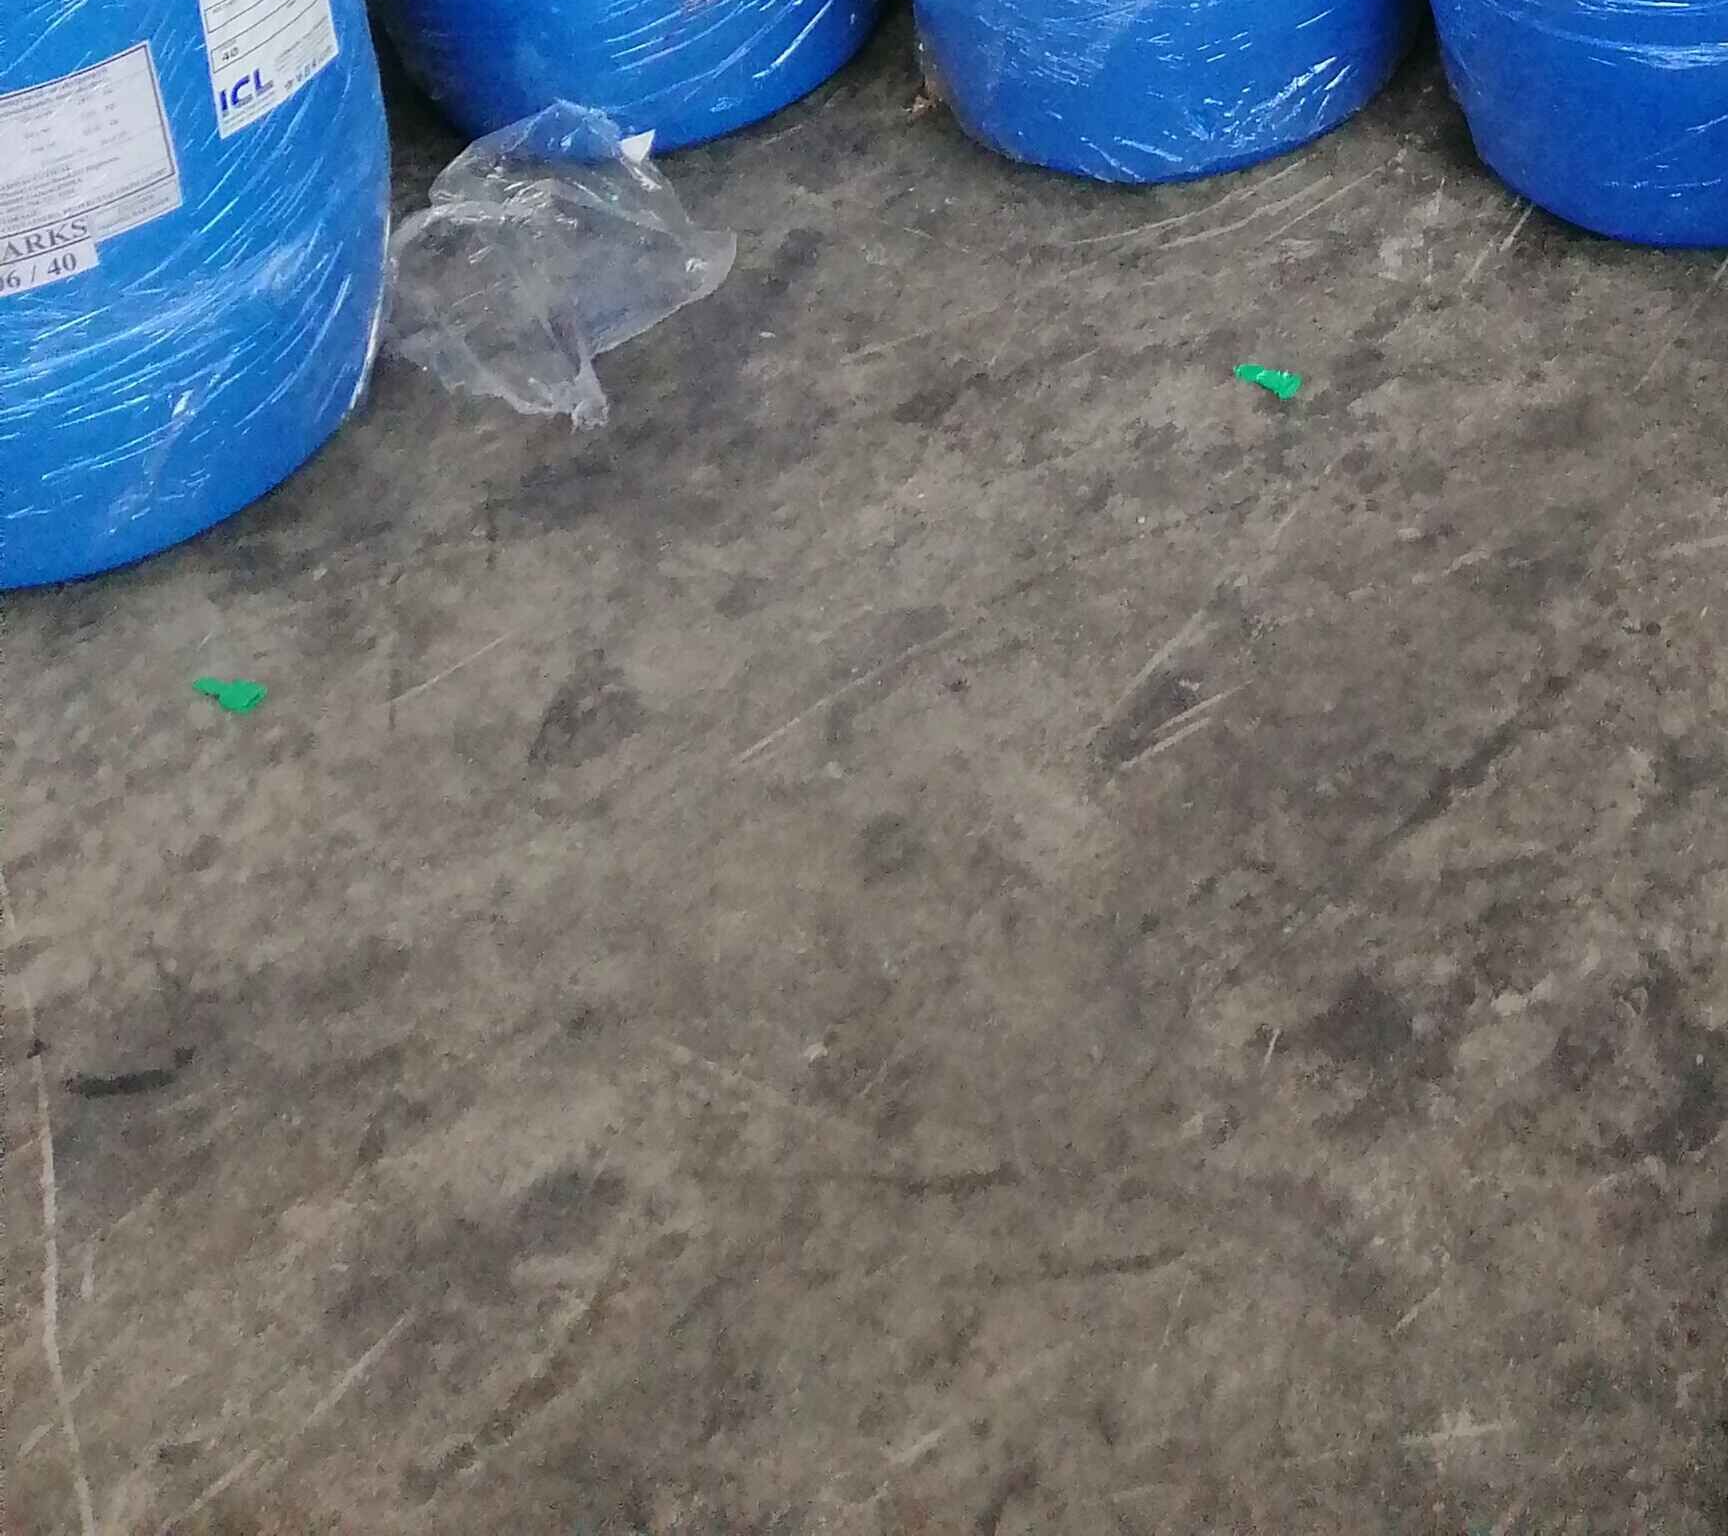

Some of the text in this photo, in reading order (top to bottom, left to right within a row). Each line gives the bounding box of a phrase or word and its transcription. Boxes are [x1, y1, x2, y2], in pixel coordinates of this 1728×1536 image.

[217, 66, 275, 115] ICL
[0, 218, 88, 261] ARKS
[48, 252, 77, 275] 40
